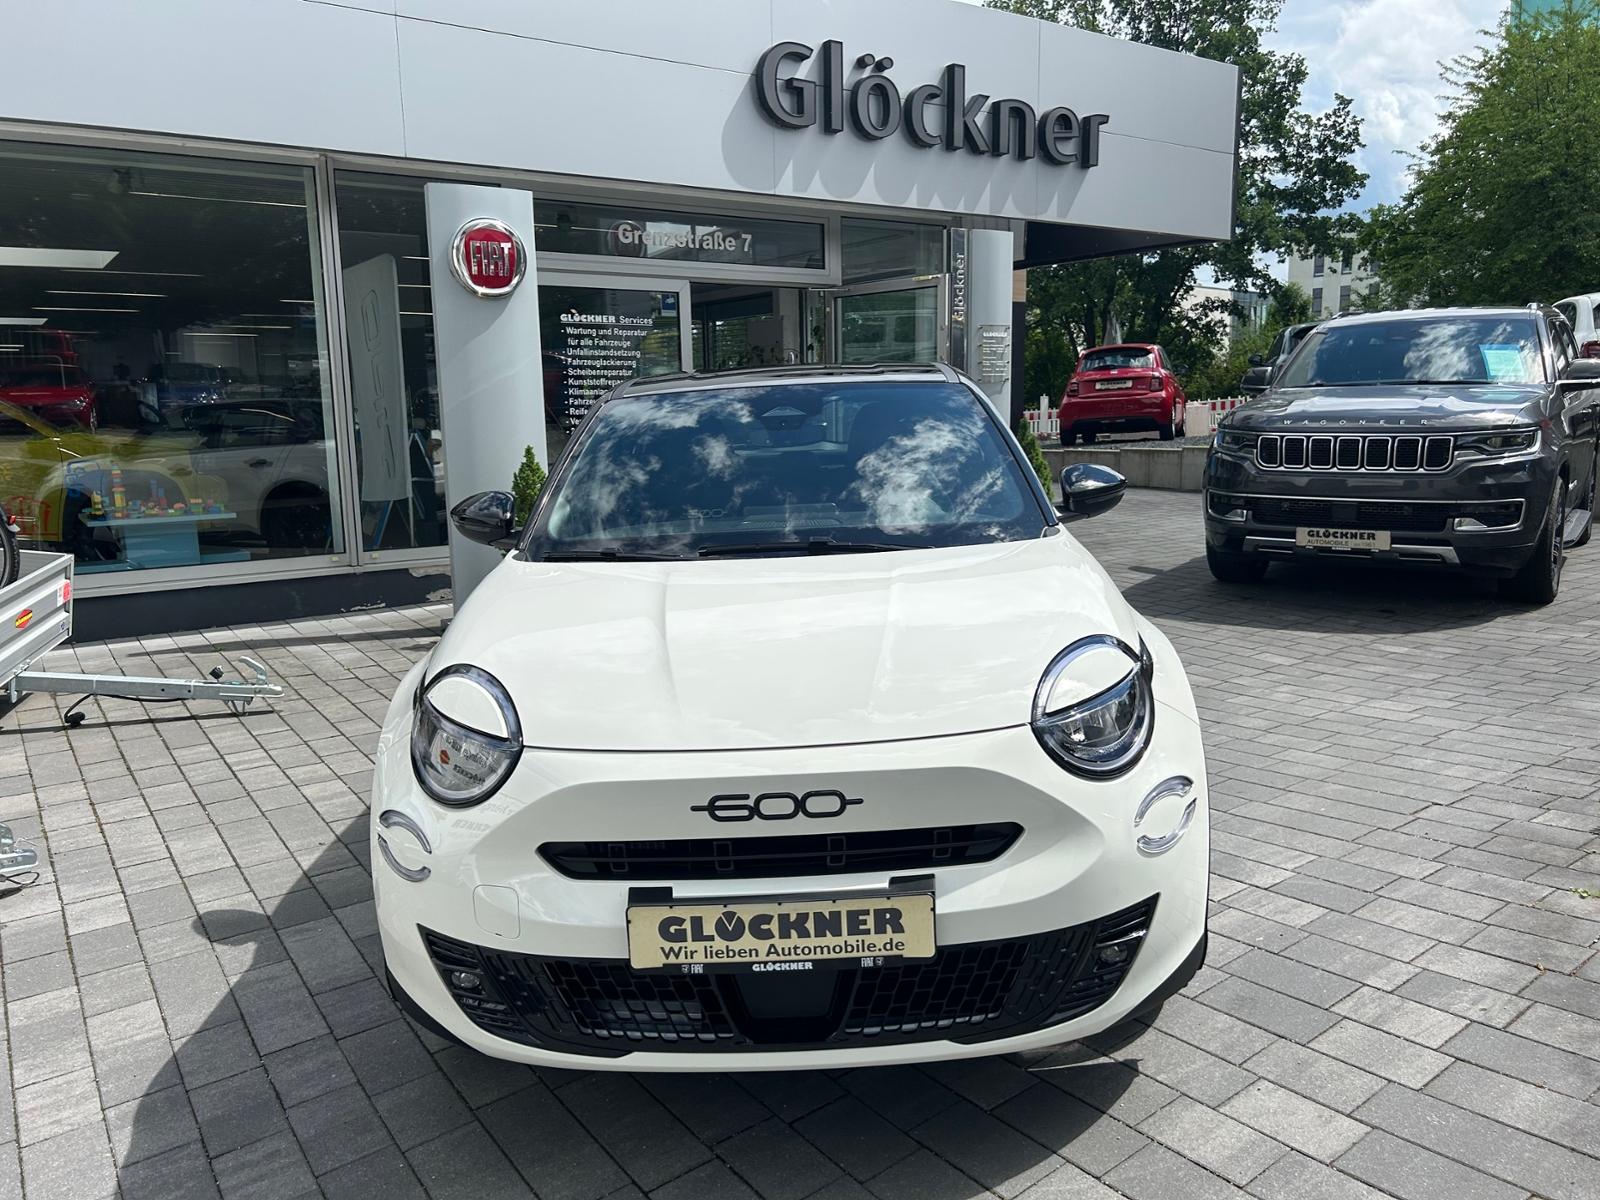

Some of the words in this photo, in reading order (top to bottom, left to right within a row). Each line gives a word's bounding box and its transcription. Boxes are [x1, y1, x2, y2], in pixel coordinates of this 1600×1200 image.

[755, 40, 1109, 168] Glöckner
[617, 223, 736, 252] Grenzstraße
[741, 233, 752, 252] 7
[470, 240, 512, 277] FIAT
[951, 252, 966, 321] Glöckner
[619, 316, 653, 325] Services
[566, 327, 597, 337] Wartung
[613, 328, 648, 337] Reparatur
[568, 338, 578, 346] für
[580, 338, 593, 346] alle
[595, 338, 631, 347] Fahrzeuge
[567, 348, 641, 358] Unfallinstandsetzung
[567, 358, 637, 368] Fahrzeuglackierung
[568, 368, 633, 377] Scheibenreparatur
[1307, 539, 1350, 547] AUTOMOBILE
[707, 790, 848, 822] 600
[660, 945, 698, 960] Wir
[704, 944, 758, 959] lieben
[766, 938, 905, 958] Automobile.de
[861, 957, 874, 967] FIAT
[691, 964, 704, 974] FIAT
